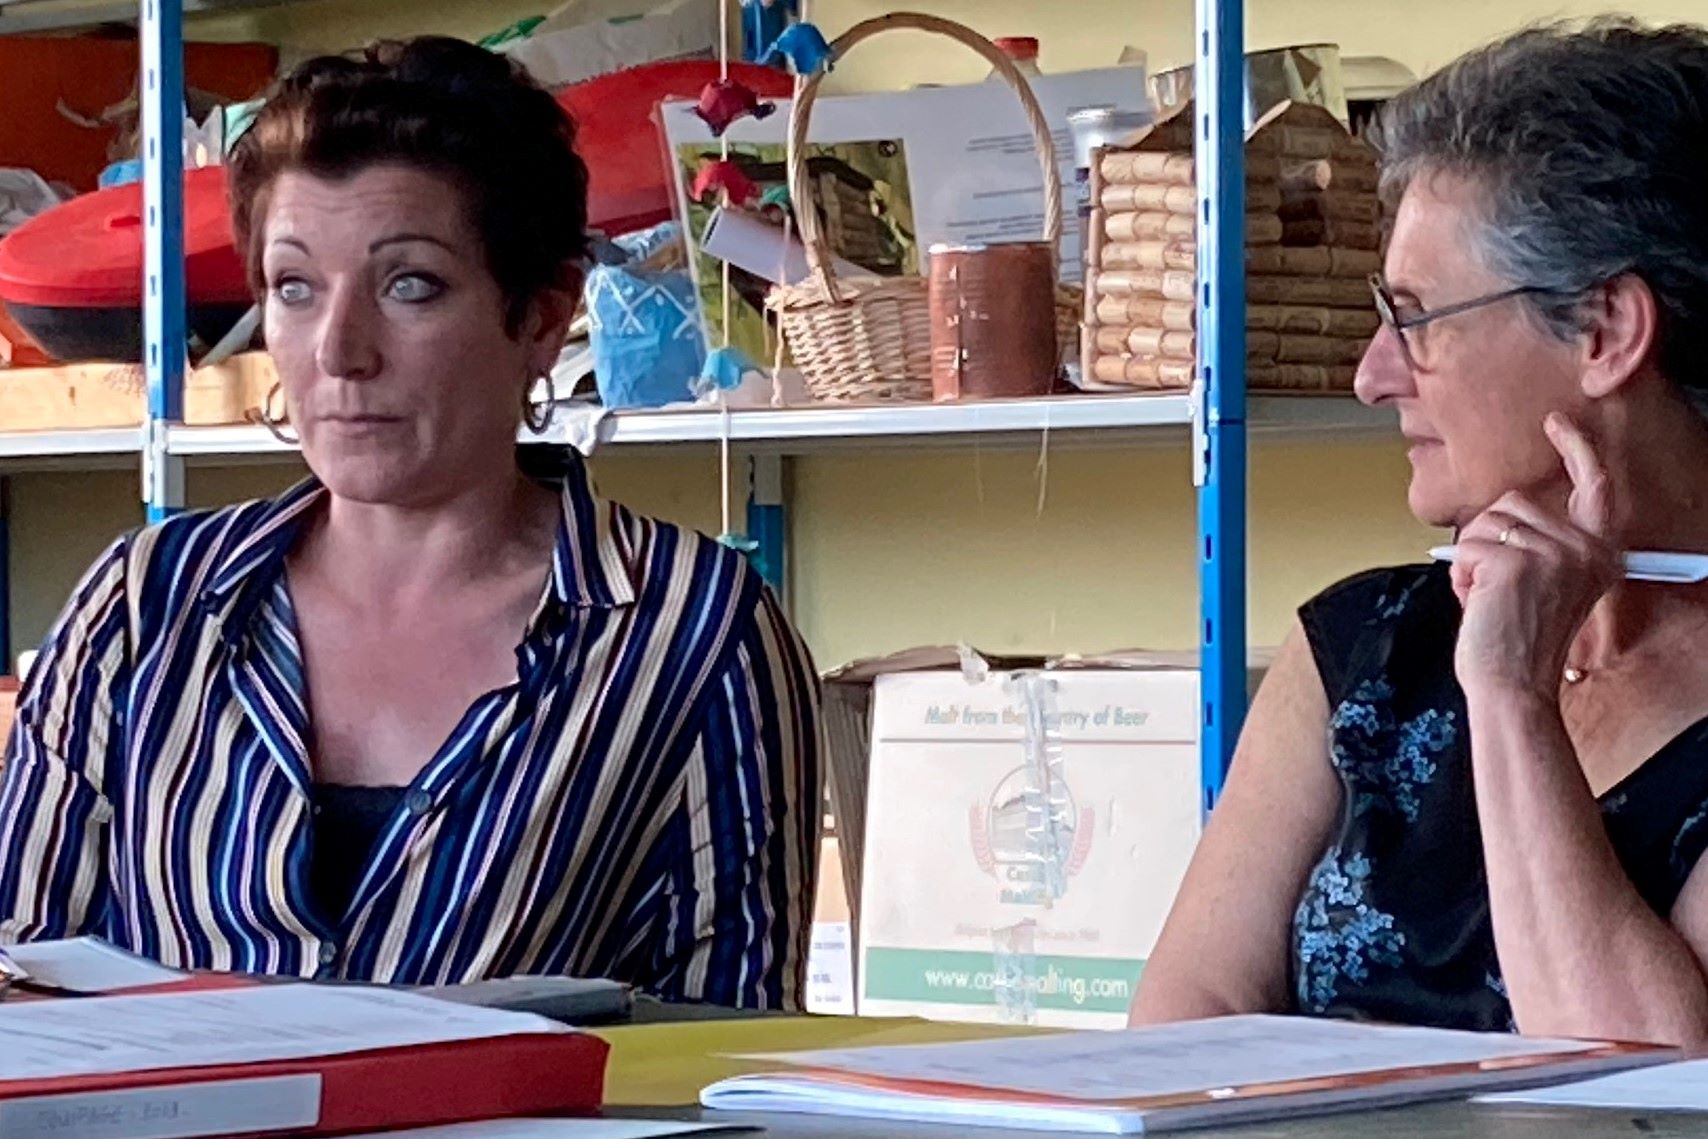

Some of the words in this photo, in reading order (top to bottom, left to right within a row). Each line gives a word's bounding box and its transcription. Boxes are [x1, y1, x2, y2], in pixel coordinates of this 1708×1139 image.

[924, 704, 959, 725] Malt
[962, 704, 998, 725] from
[1092, 704, 1111, 726] of
[1113, 706, 1151, 726] Beer
